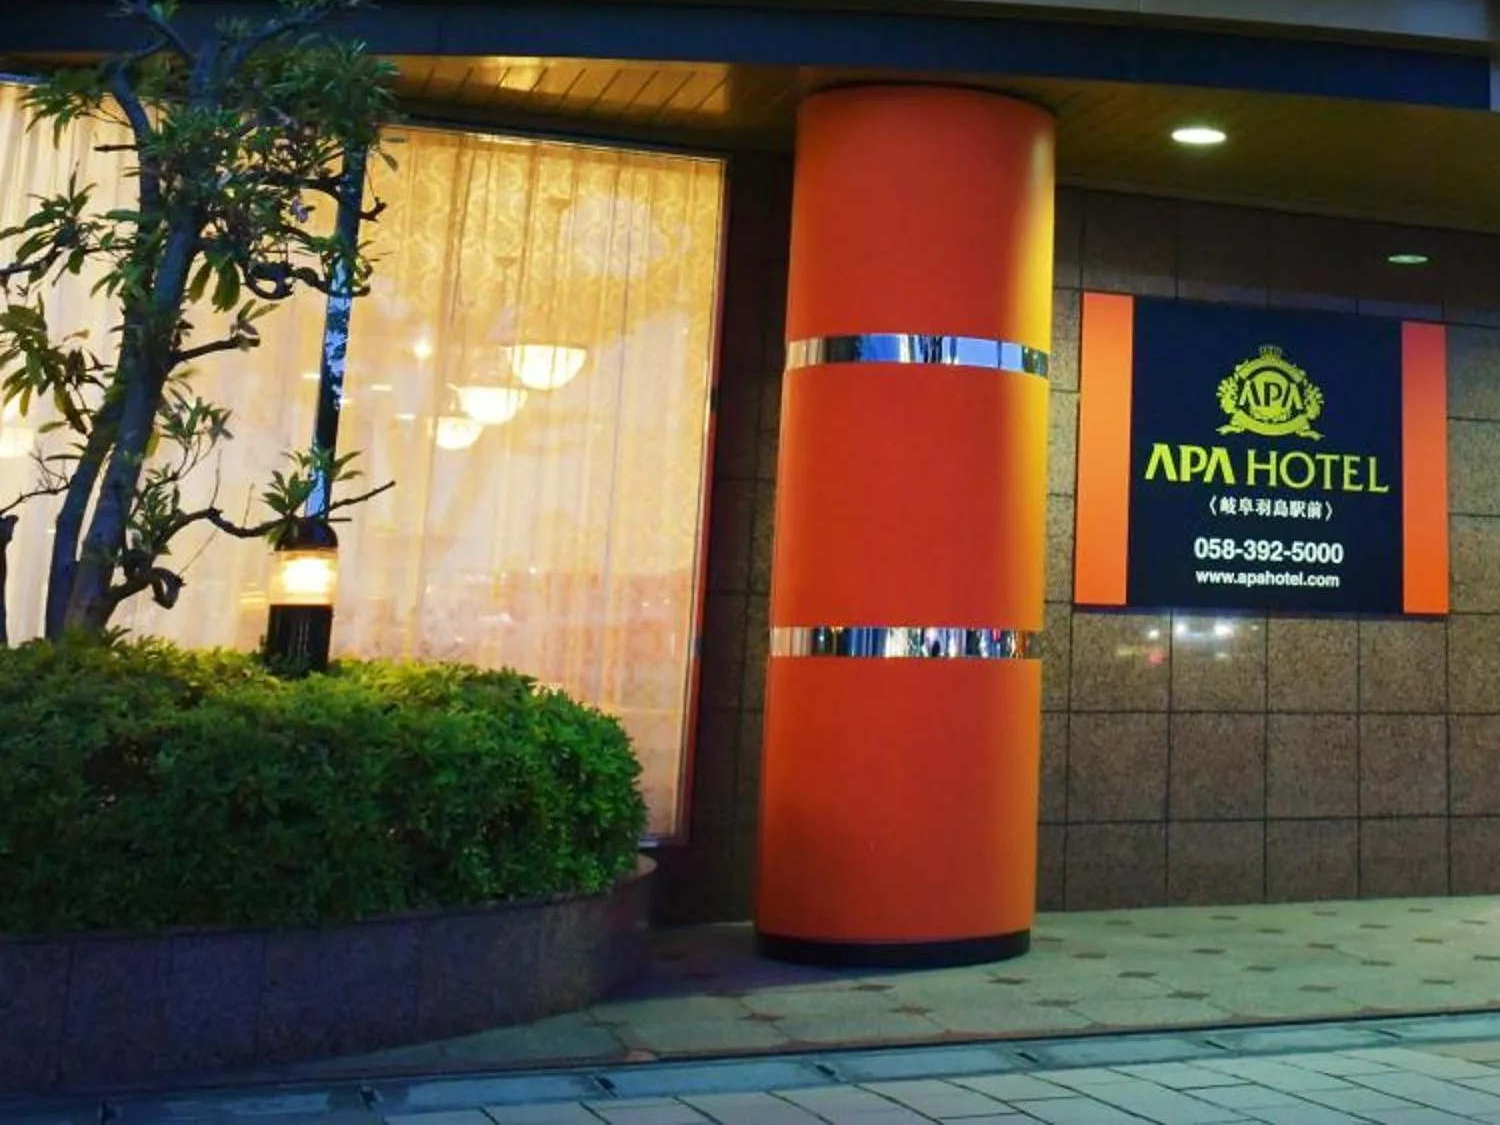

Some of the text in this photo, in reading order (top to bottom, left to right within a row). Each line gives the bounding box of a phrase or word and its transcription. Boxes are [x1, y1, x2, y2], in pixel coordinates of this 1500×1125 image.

[1239, 379, 1303, 410] APA
[1145, 442, 1389, 492] APA HOTEL
[1194, 536, 1344, 564] 058-392-5000
[1195, 571, 1341, 588] www.apahotel.com
